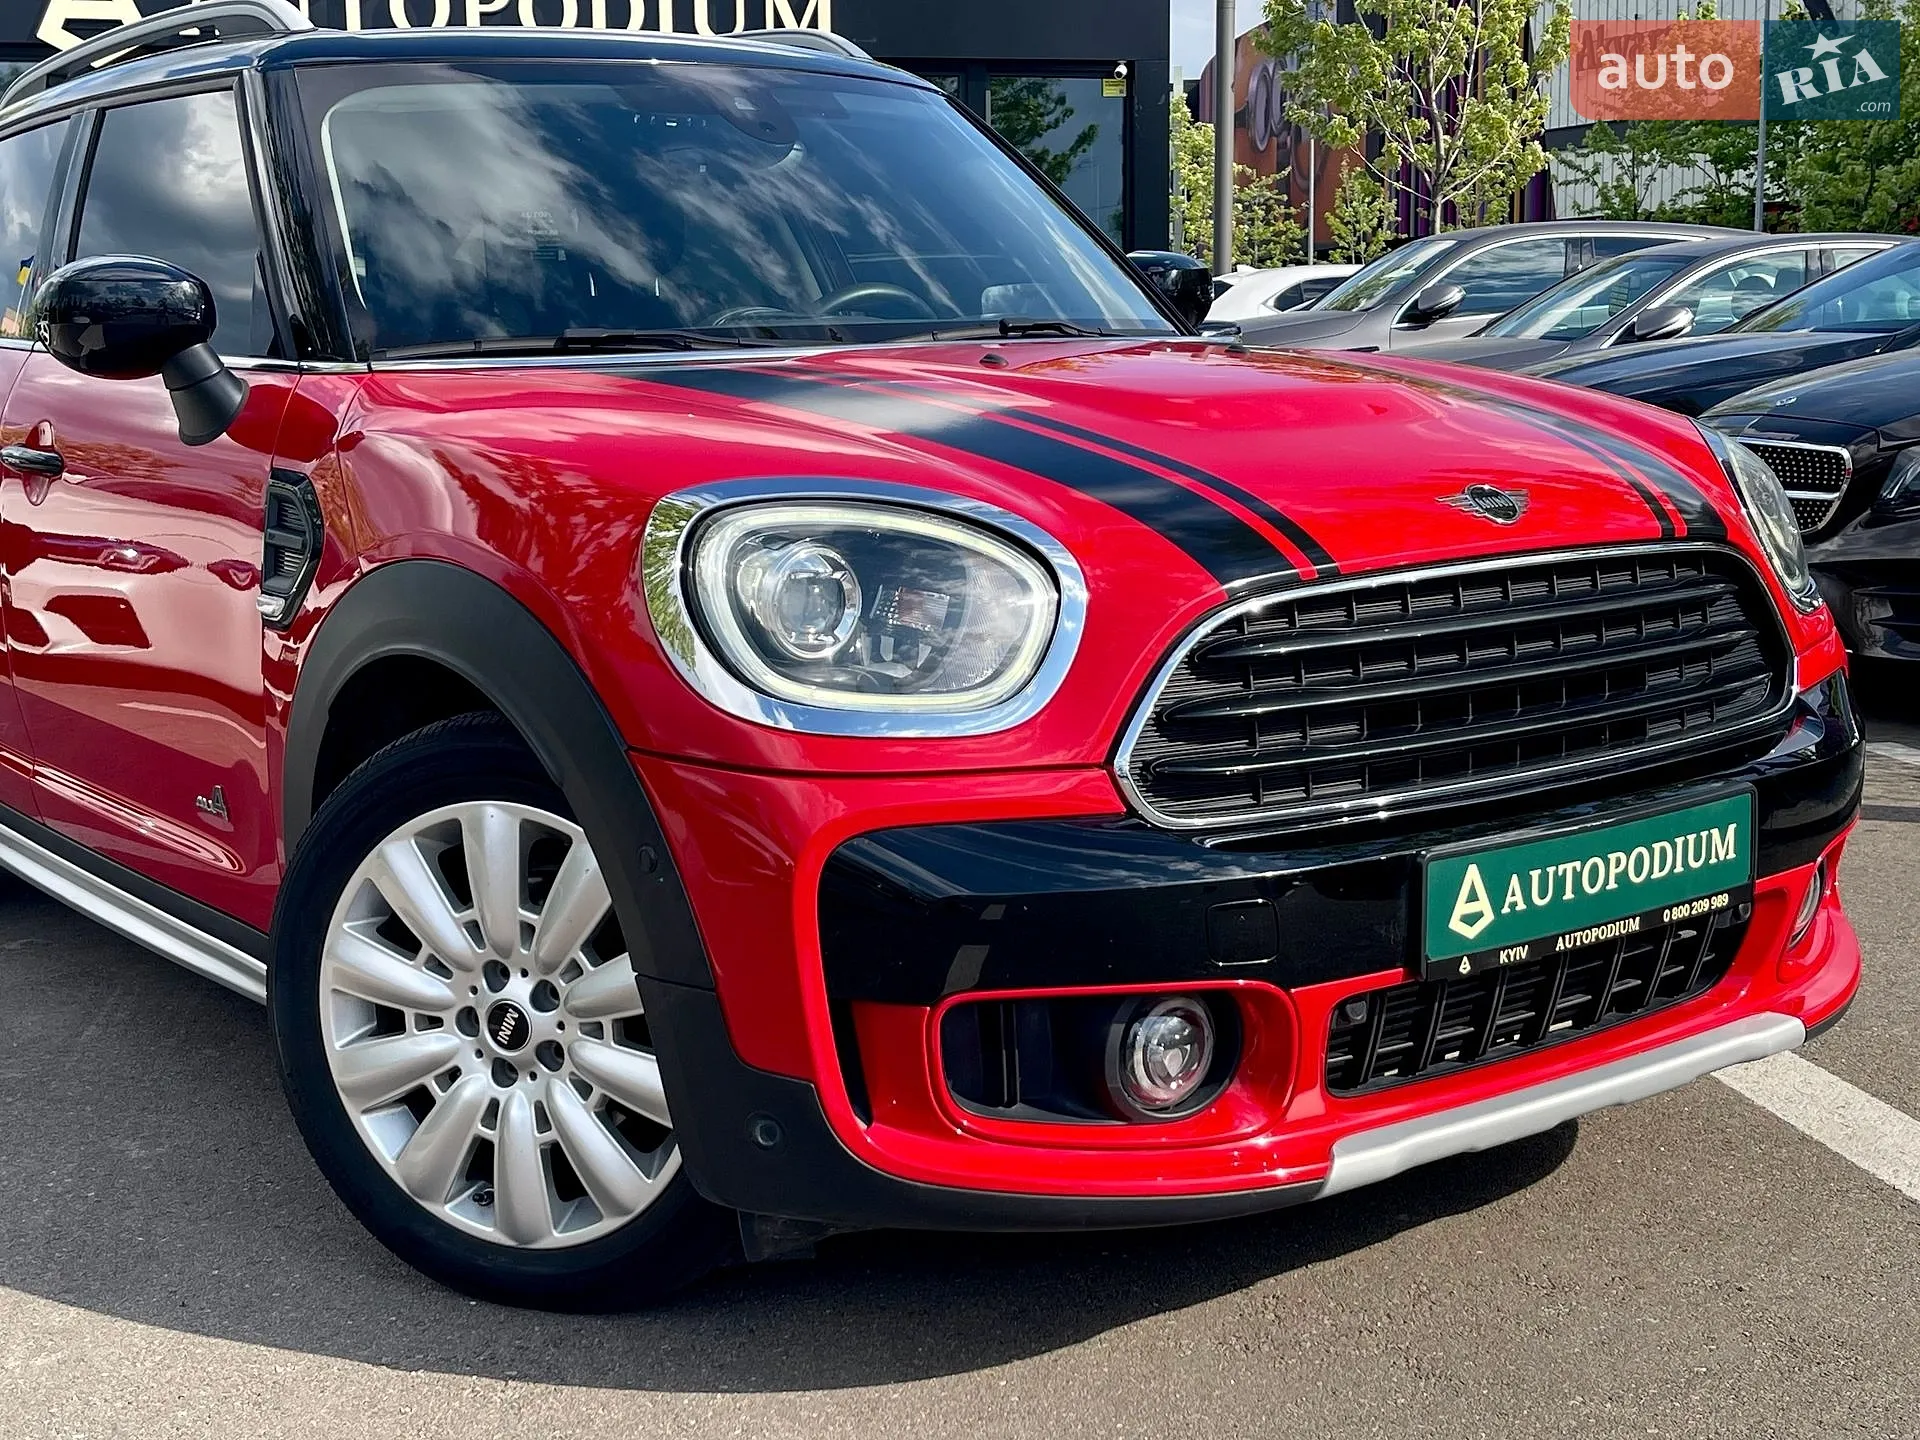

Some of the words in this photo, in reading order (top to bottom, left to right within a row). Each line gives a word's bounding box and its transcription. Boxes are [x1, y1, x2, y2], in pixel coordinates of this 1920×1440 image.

[178, 0, 831, 37] OPODIUM
[1475, 495, 1514, 510] MINI
[1501, 823, 1738, 914] AUTOPODIUM
[1499, 945, 1529, 964] KYIV
[1555, 916, 1641, 952] AUTOPODIUM
[1663, 911, 1670, 923] 0
[1671, 904, 1690, 921] 800
[1691, 900, 1709, 917] 209
[1710, 893, 1729, 912] 989
[497, 1008, 520, 1045] MINI
